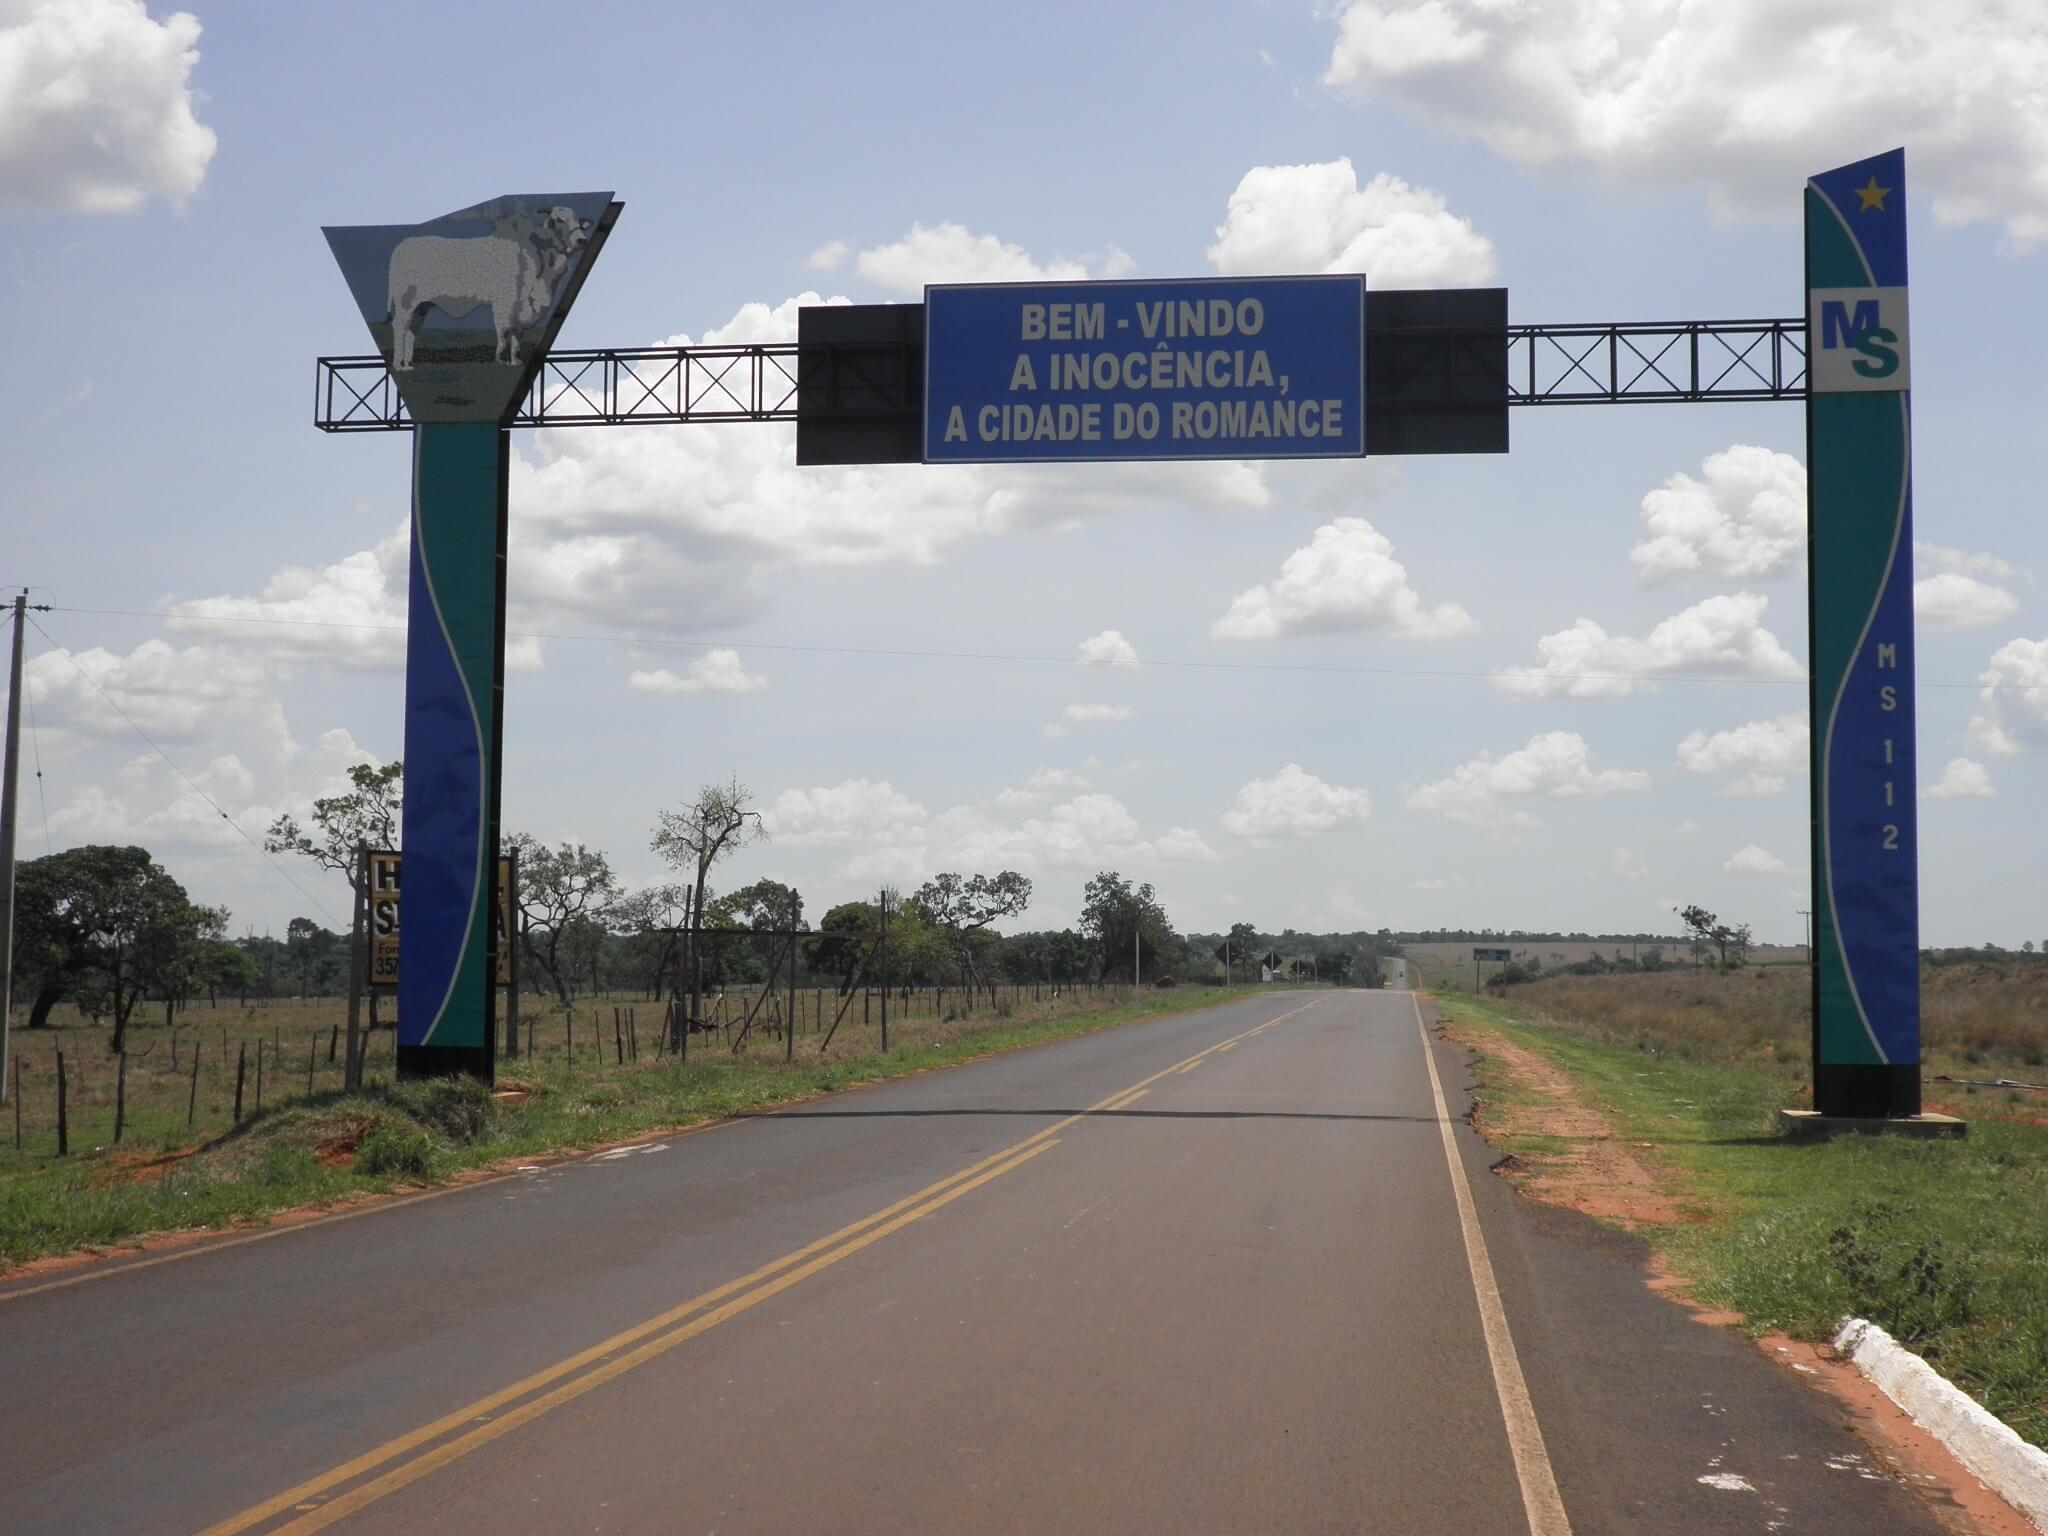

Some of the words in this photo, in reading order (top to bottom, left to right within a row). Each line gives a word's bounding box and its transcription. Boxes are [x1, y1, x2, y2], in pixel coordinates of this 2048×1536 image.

[1021, 303, 1105, 341] BEM
[1136, 298, 1265, 338] VINDO
[1821, 299, 1900, 379] MS
[1009, 354, 1037, 391] A
[1050, 341, 1290, 396] INOCÊNCIA,
[944, 405, 968, 442] A
[978, 402, 1101, 442] CIDADE
[1113, 402, 1160, 441] DO
[1172, 398, 1343, 440] ROMANCE
